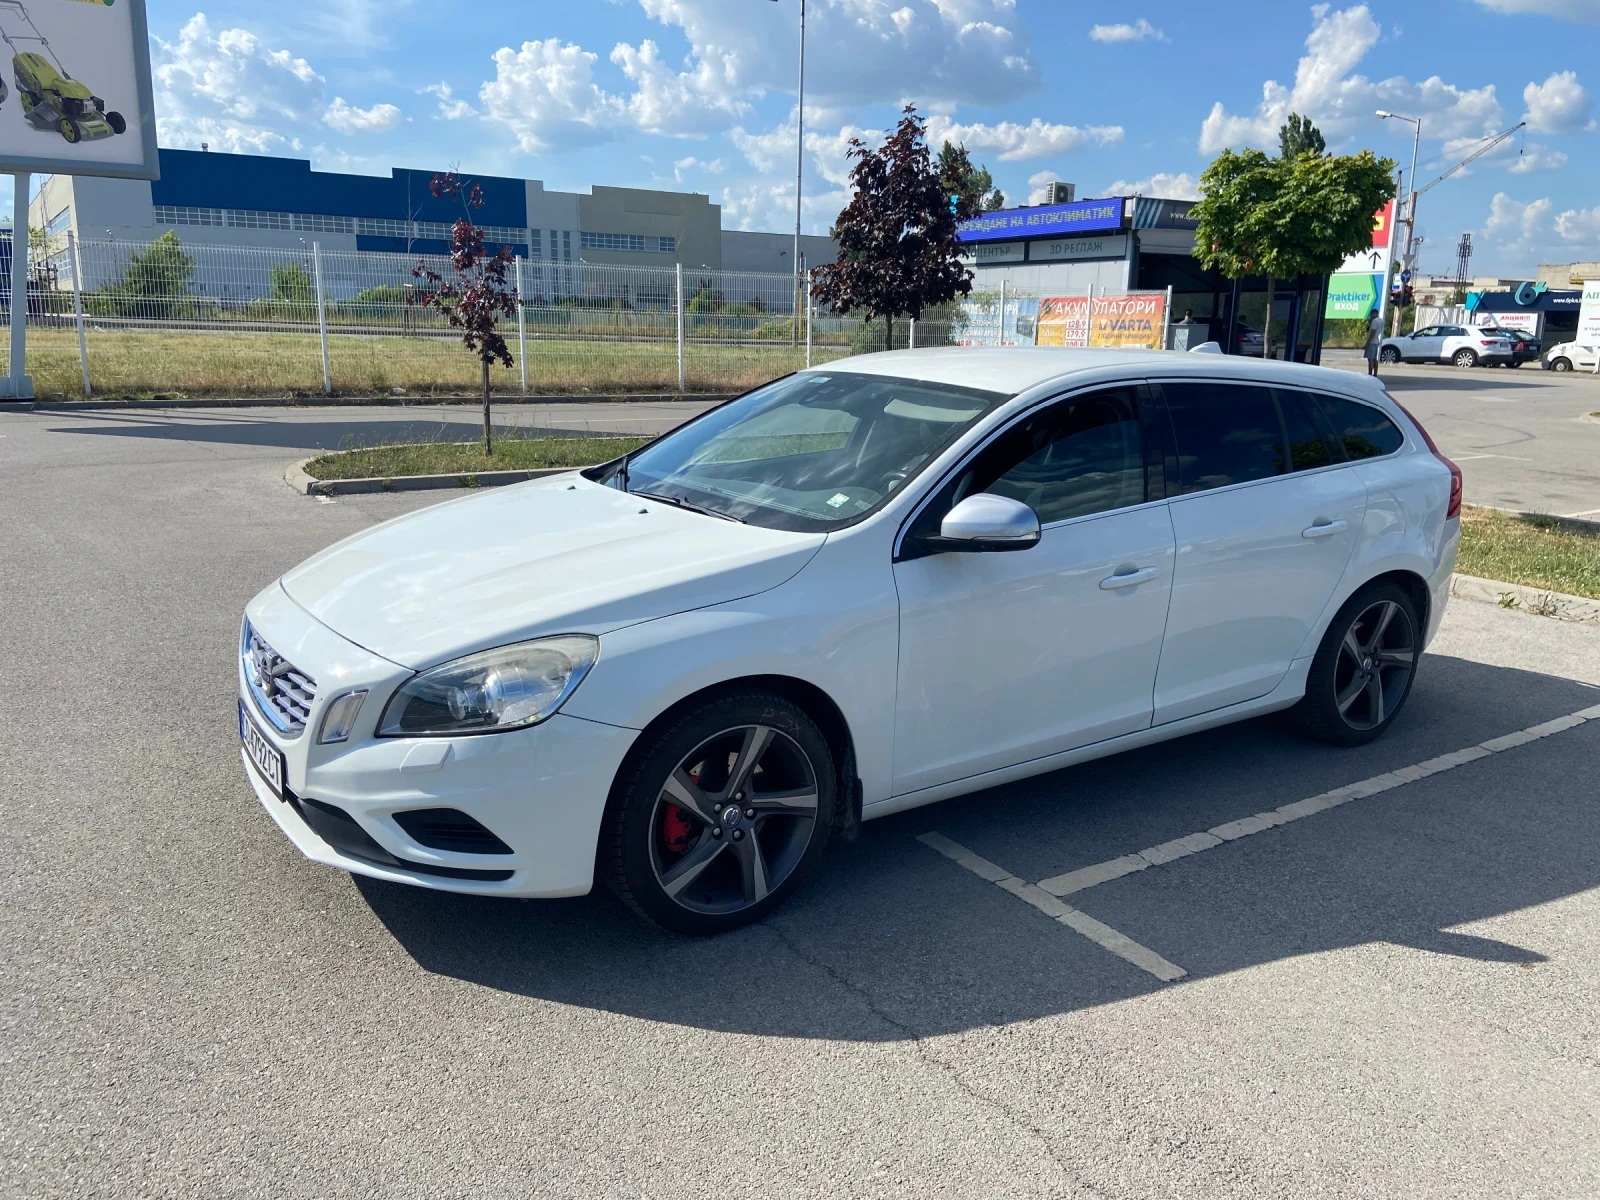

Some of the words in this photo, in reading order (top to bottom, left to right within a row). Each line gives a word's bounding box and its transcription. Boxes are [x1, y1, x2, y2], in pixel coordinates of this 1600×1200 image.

[957, 217, 1007, 232] АРЕЖДАНЕ
[1010, 215, 1024, 227] НА
[1026, 206, 1116, 226] АВТОКЛИМАТИК
[960, 246, 1011, 259] ОЦЕНТЪР
[1050, 244, 1062, 255] 3D
[1064, 241, 1103, 254] РЕГЛАЖ
[1110, 319, 1152, 331] VARTA
